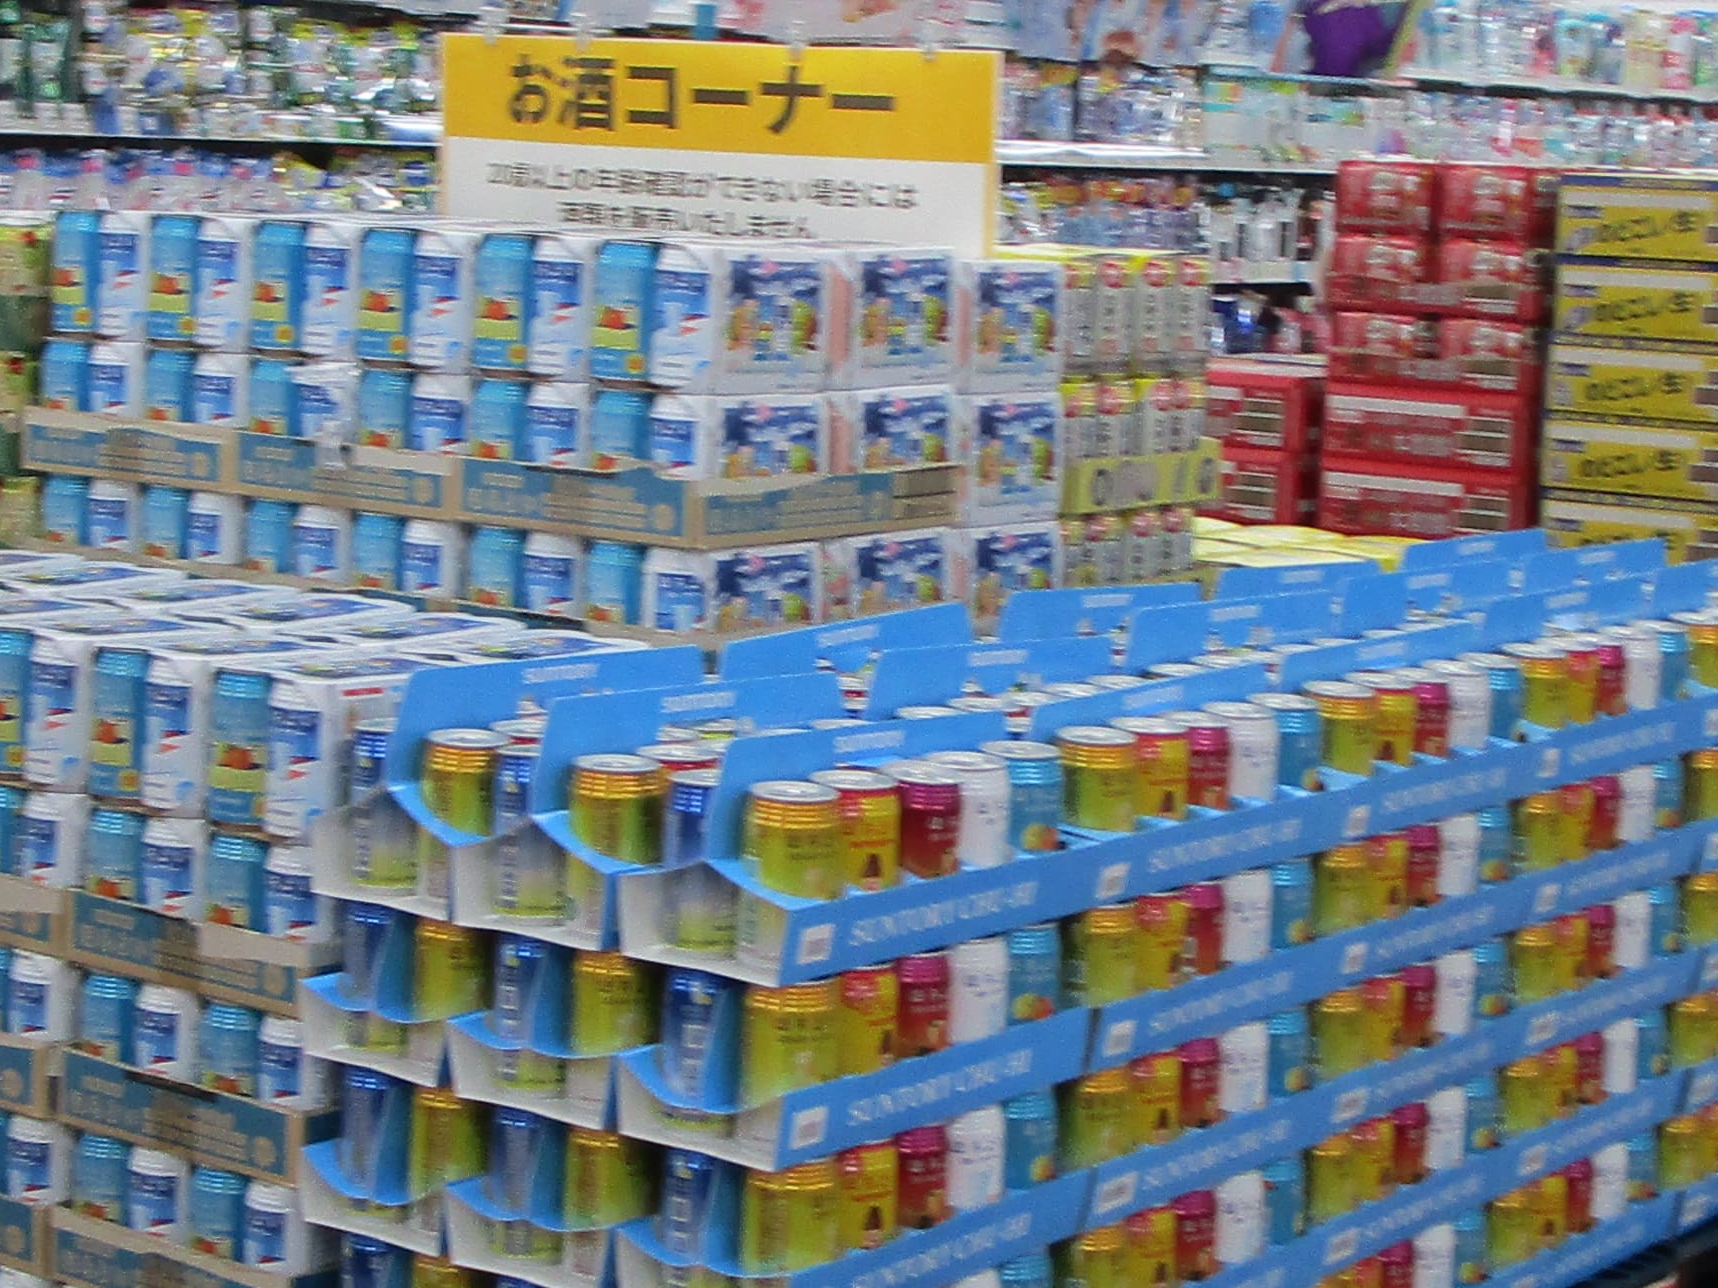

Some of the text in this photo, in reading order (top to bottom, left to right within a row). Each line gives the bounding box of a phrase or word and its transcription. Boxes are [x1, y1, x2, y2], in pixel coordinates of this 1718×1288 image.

[508, 54, 897, 134] お酒コーナー
